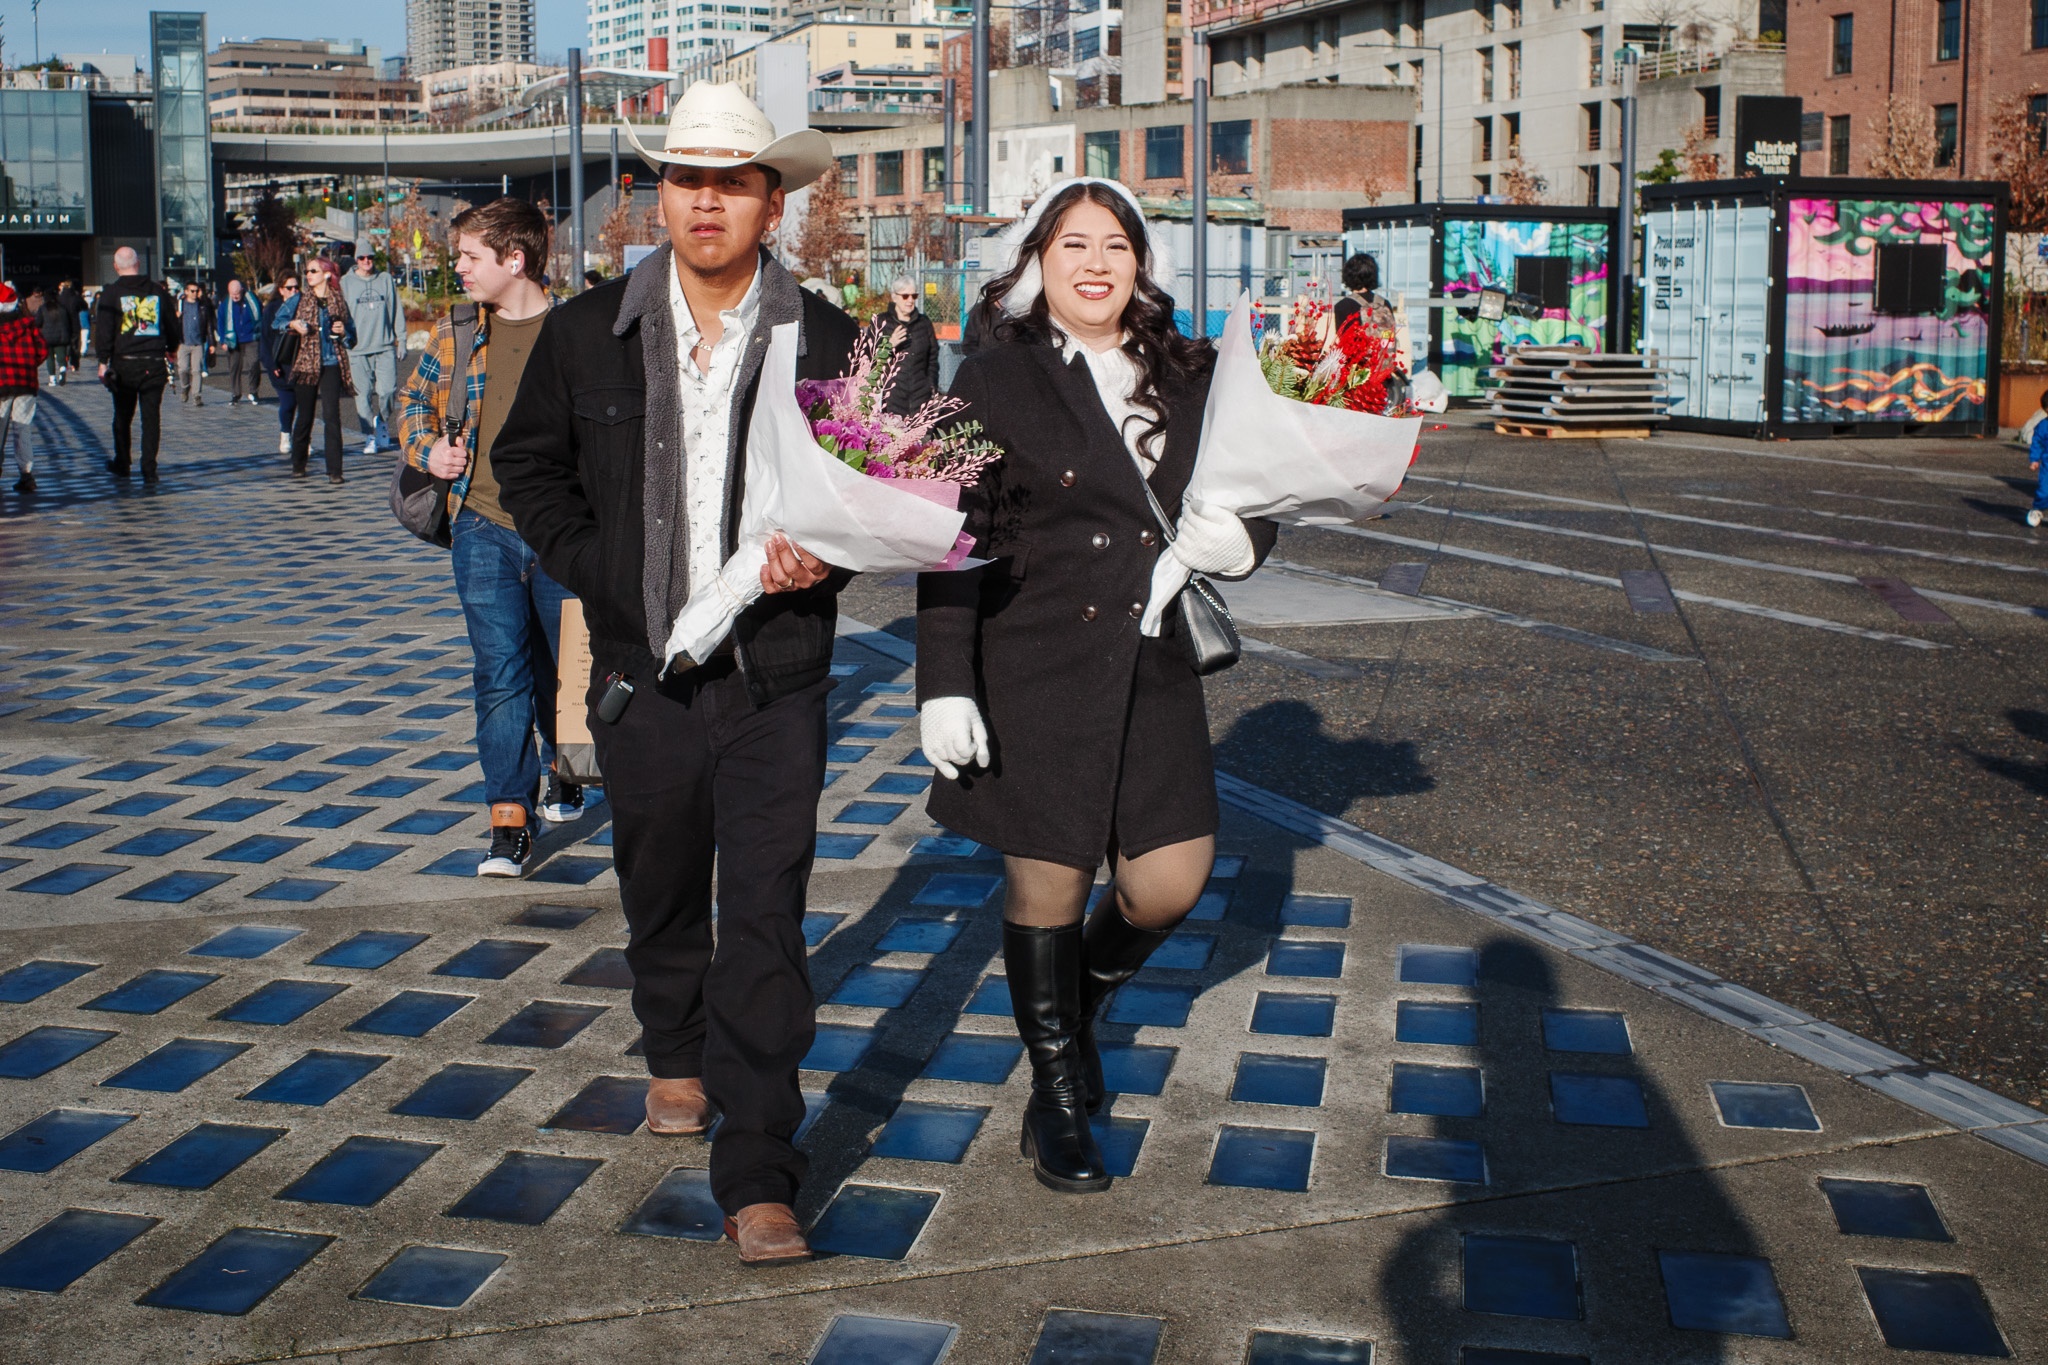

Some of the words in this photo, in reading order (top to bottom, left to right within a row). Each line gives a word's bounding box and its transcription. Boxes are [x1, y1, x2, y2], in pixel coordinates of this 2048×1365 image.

[1754, 140, 1798, 156] Market
[1745, 151, 1791, 168] Square
[1763, 165, 1790, 175] BUILDING
